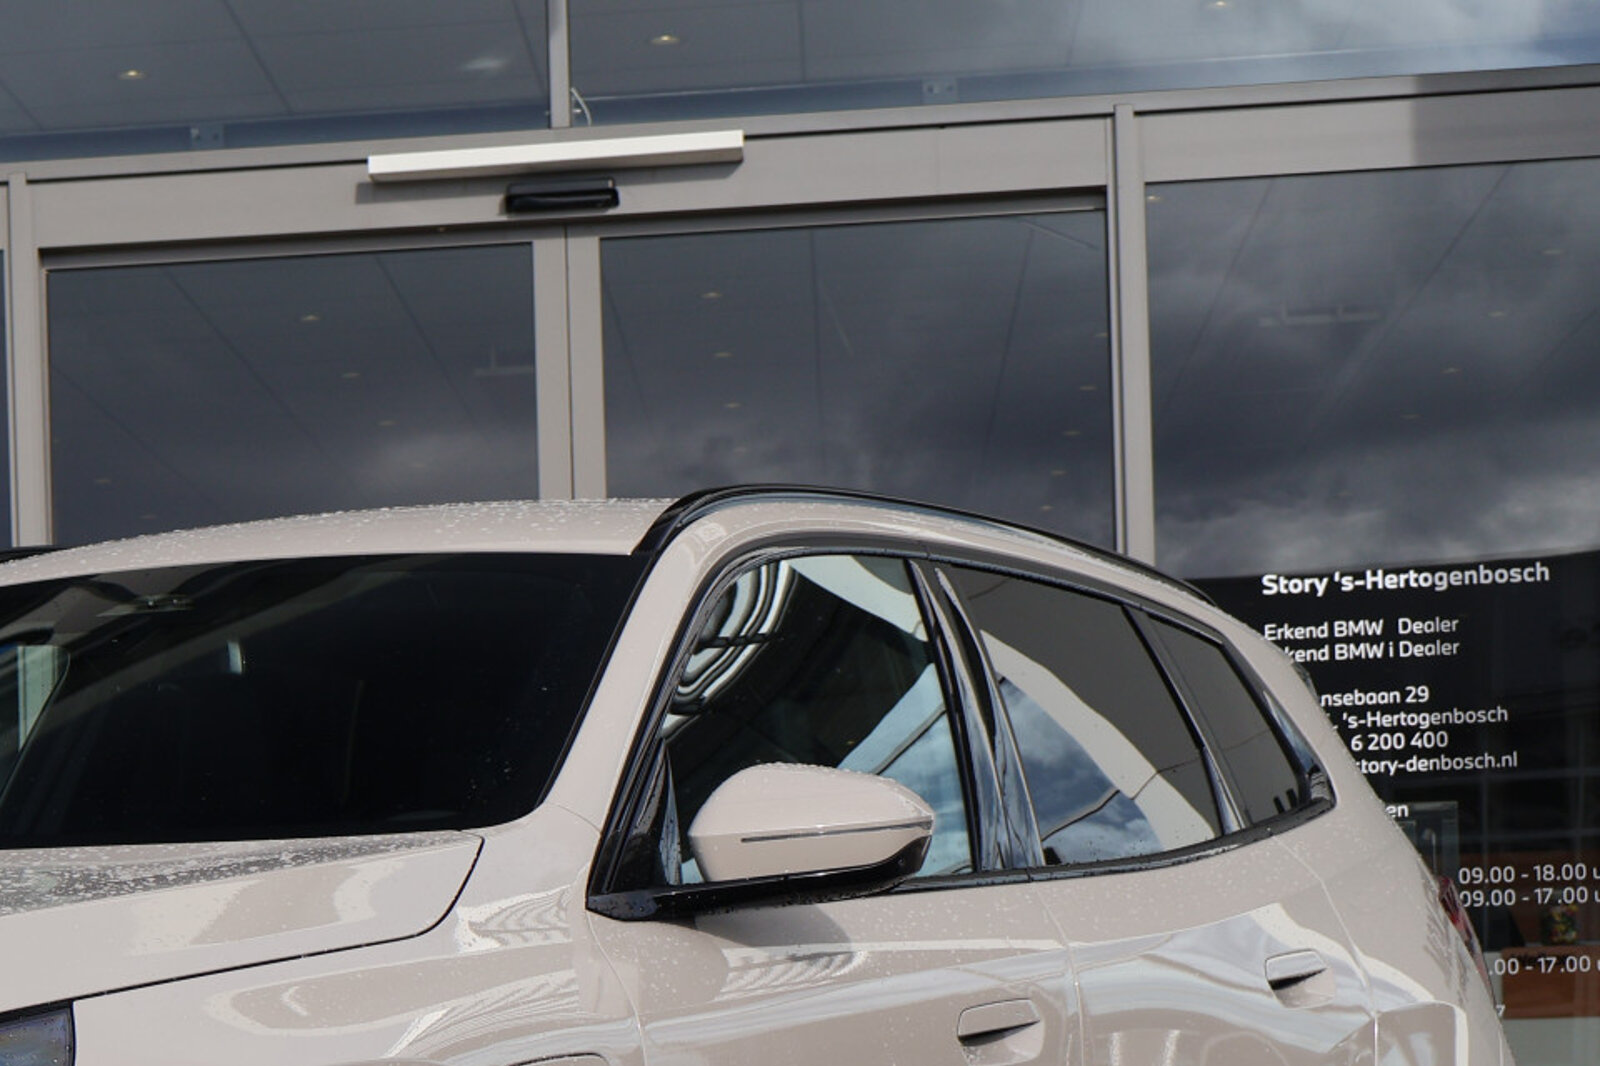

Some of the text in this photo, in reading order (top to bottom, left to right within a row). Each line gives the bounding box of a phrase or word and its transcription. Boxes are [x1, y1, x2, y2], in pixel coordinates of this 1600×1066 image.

[1261, 573, 1328, 597] Story
[1264, 616, 1460, 641] Erkend BMW Dealer
[1284, 639, 1461, 663] kend BMW i Dealer
[1404, 685, 1430, 703] 29
[1351, 730, 1449, 751] 6 200 400
[1356, 750, 1519, 776] tory-denbosch.nl
[1458, 865, 1516, 885] 09.00
[1532, 862, 1588, 882] 18.00
[1459, 888, 1517, 908] 09.00
[1534, 886, 1589, 906] 17.00
[1488, 957, 1520, 976] .00
[1537, 955, 1592, 974] 17.00
